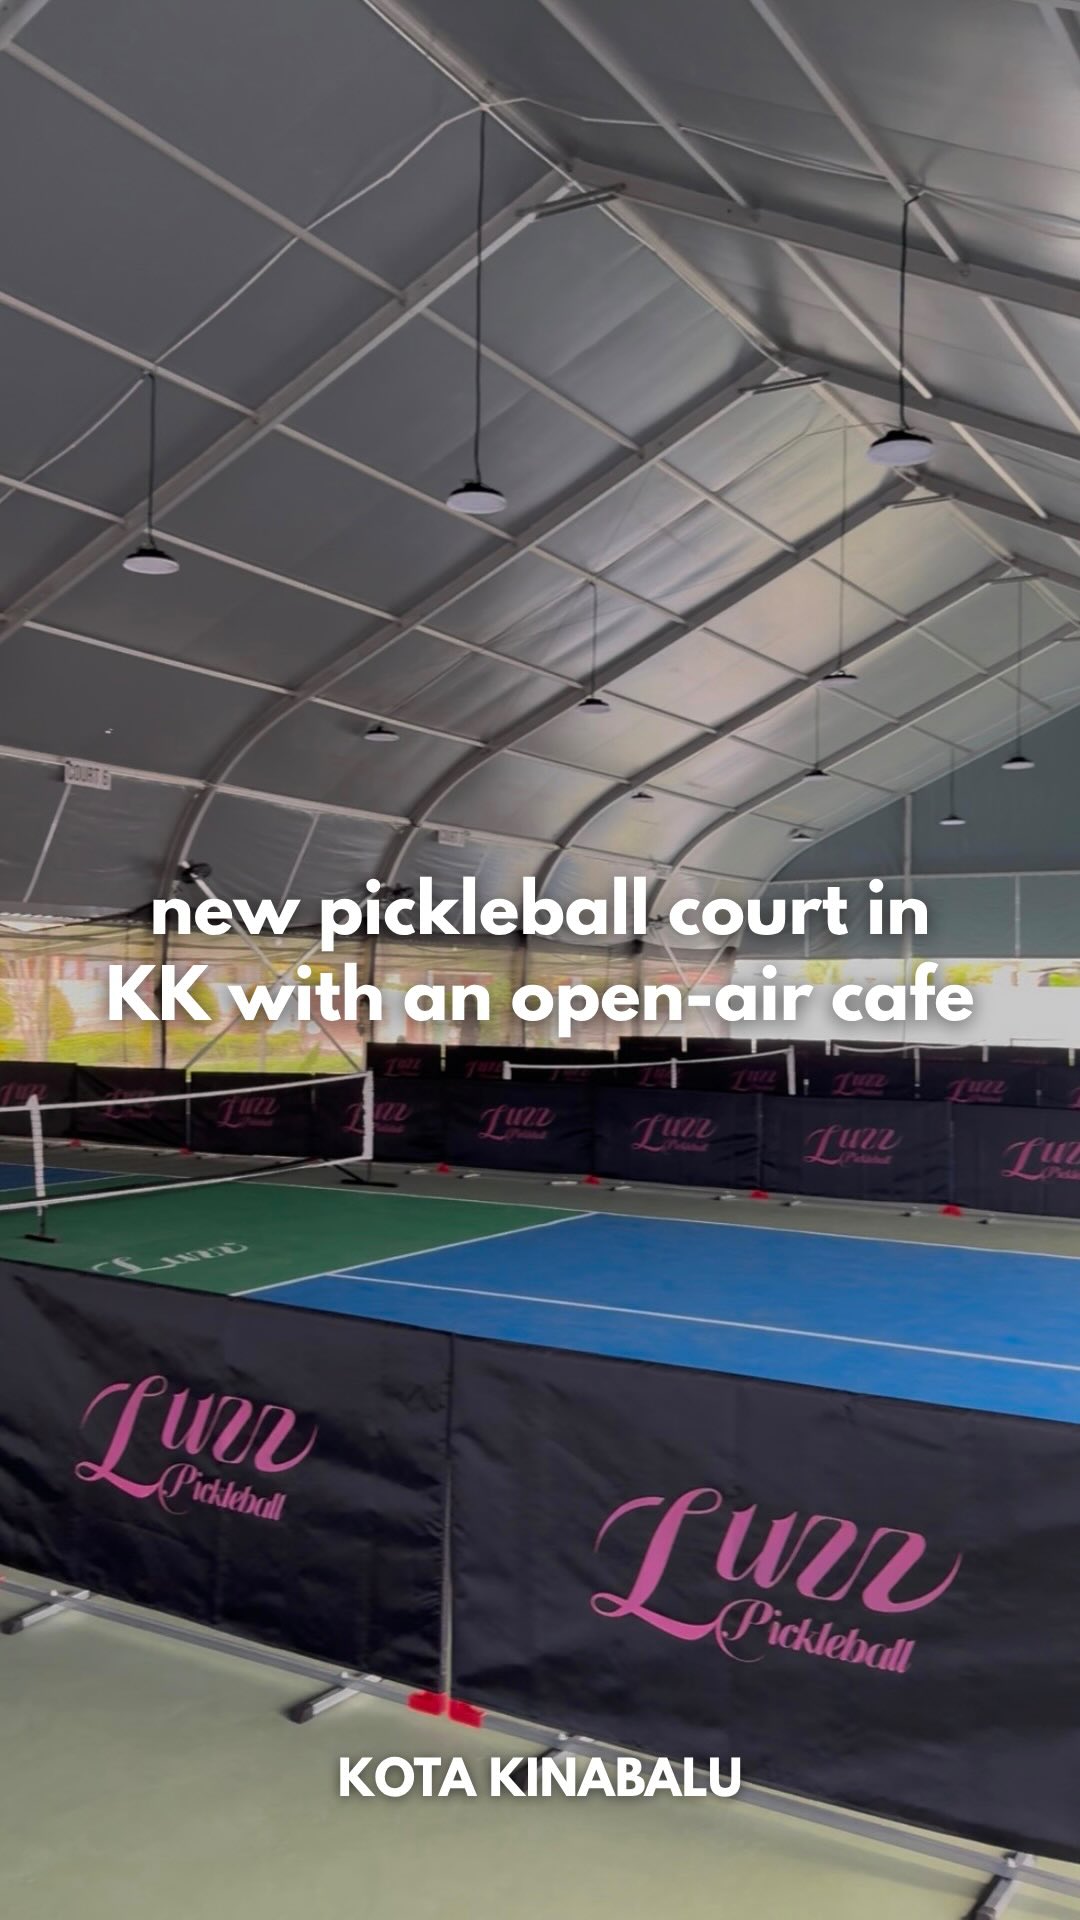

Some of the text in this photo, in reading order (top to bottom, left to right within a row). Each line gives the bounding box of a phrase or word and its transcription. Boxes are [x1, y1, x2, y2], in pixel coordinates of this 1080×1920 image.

[477, 1103, 556, 1141] Luzz
[631, 1112, 720, 1152] Luzz
[802, 1122, 904, 1166] Luzz
[75, 1375, 319, 1498] Luzz
[157, 1462, 288, 1521] Pickleball
[590, 1487, 963, 1641] Luzz
[714, 1598, 916, 1674] Pickleball
